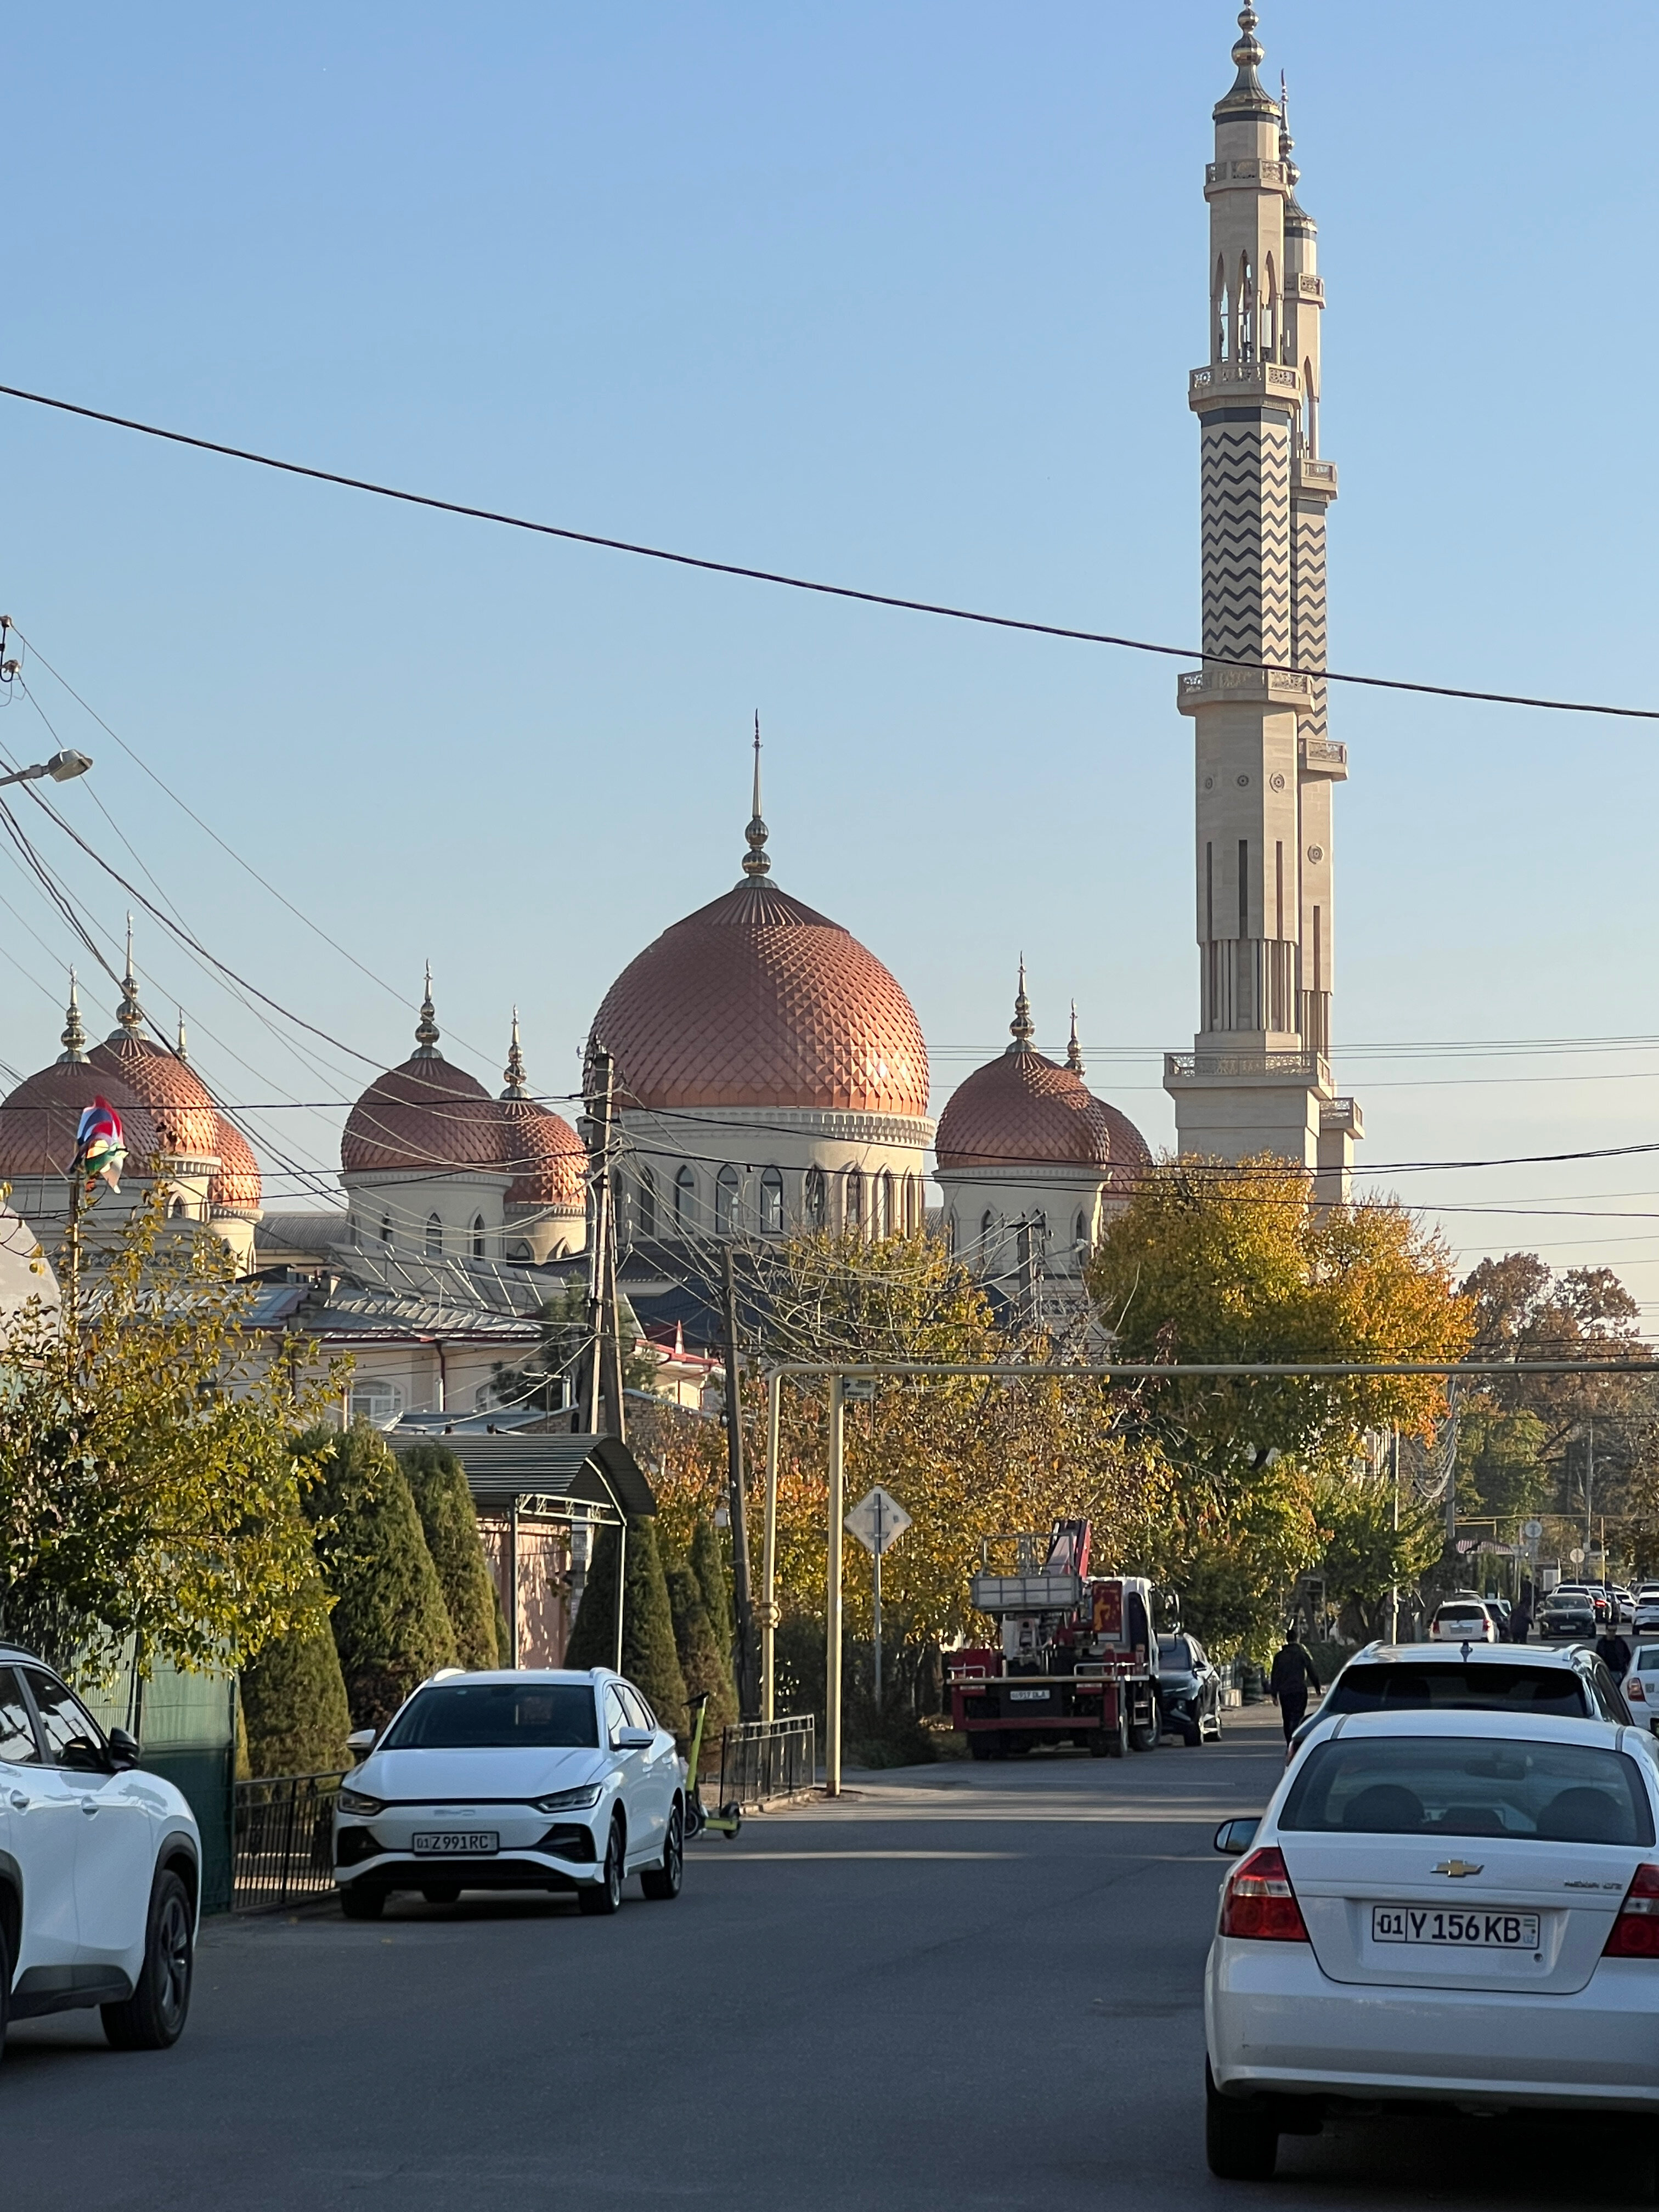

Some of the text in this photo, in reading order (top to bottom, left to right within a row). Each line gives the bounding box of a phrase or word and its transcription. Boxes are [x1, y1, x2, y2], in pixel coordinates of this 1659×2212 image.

[416, 1838, 429, 1848] 01
[1380, 1914, 1403, 1934] 01
[1523, 1935, 1536, 1944] UZ
